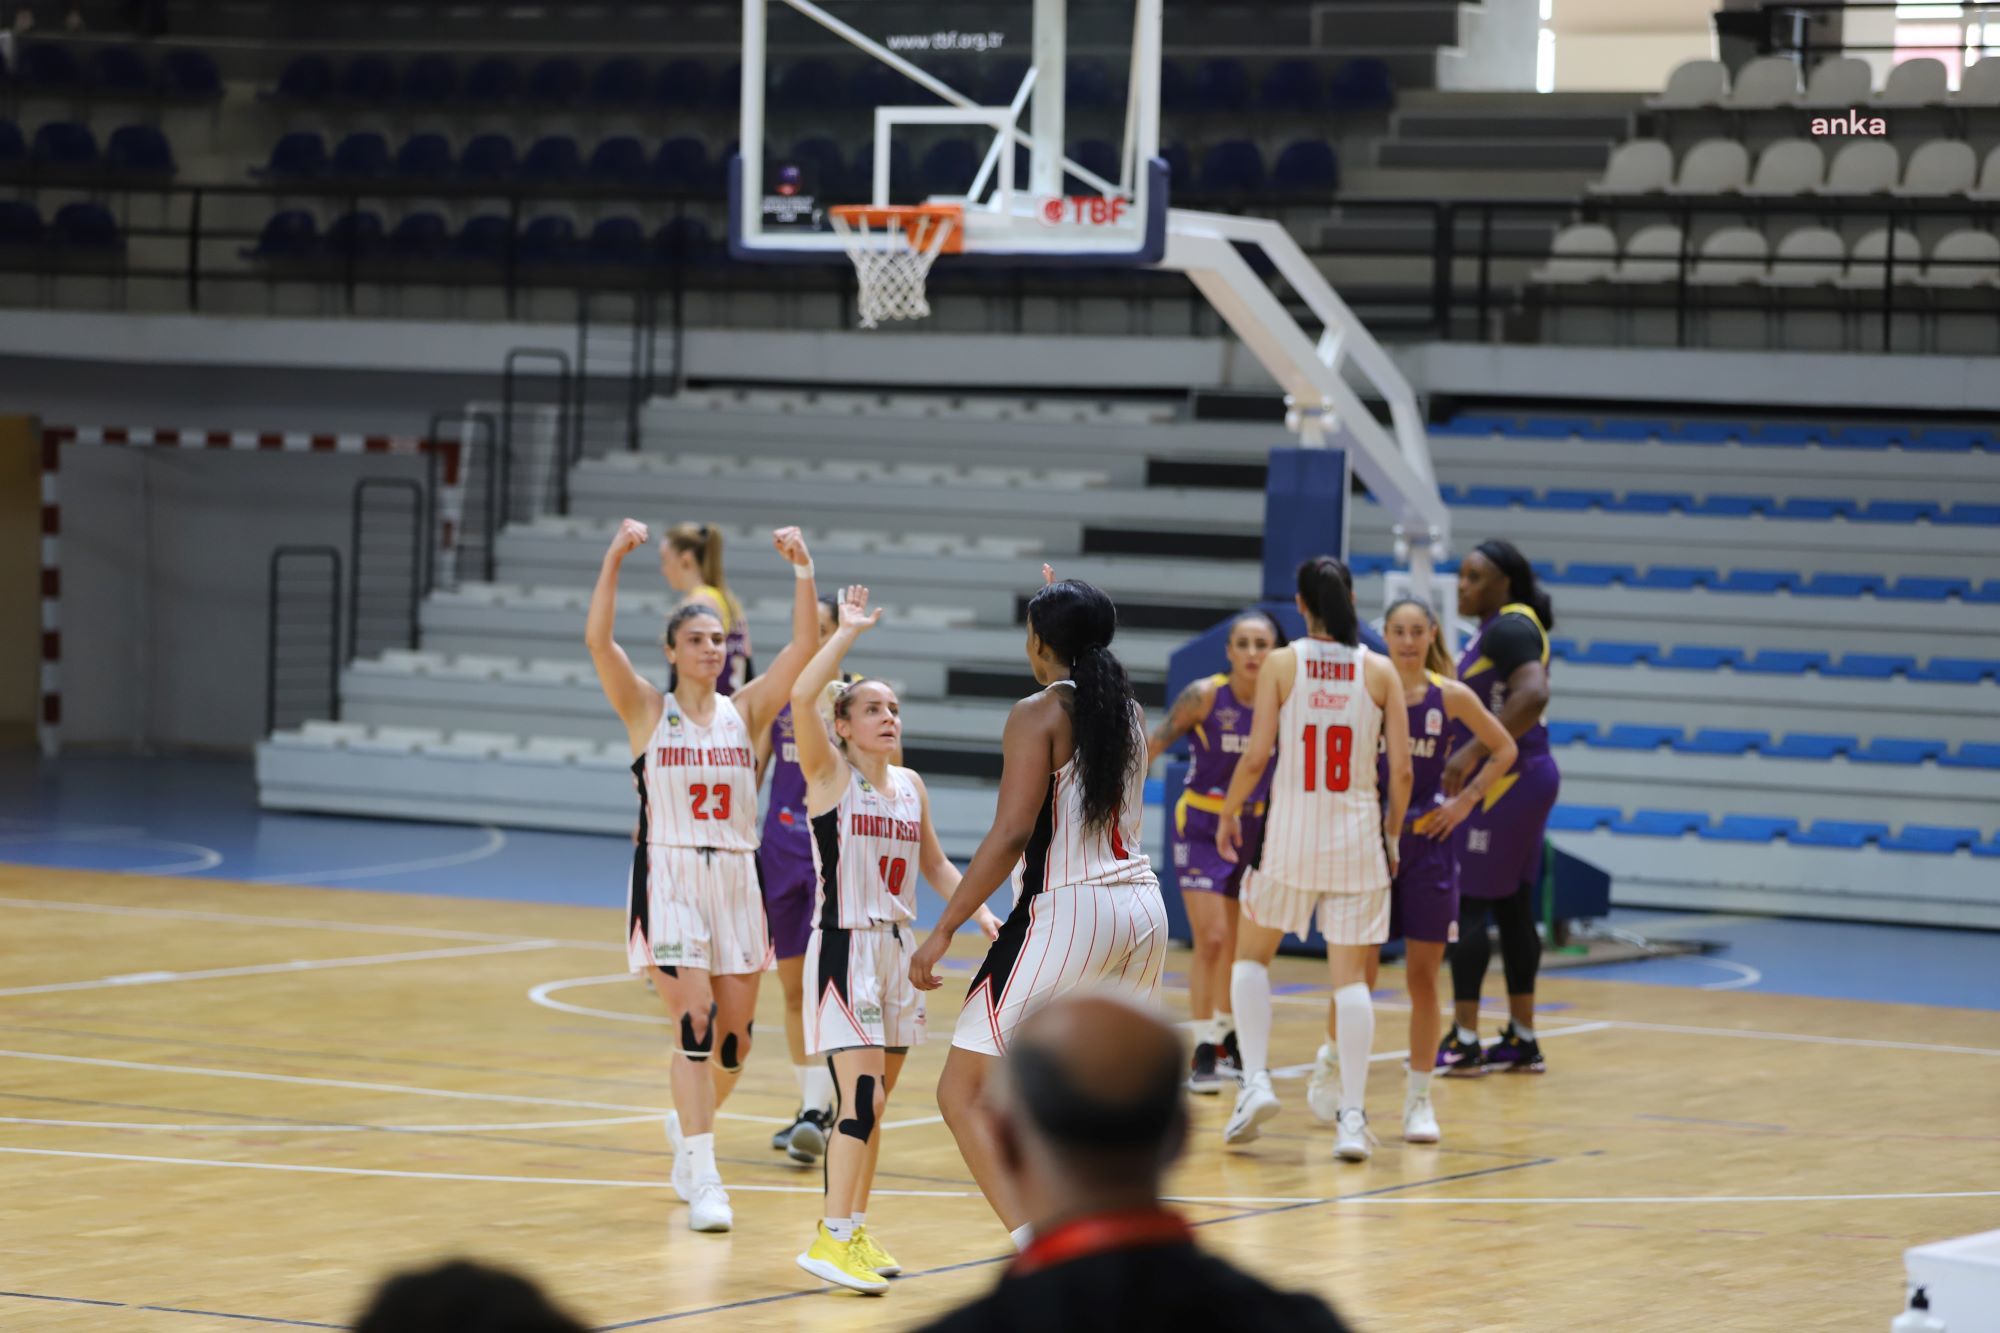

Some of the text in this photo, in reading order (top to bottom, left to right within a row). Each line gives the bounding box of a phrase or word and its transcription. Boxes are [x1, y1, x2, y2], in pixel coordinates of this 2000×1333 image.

[886, 31, 1005, 52] www.tbf.org.tr
[1071, 195, 1126, 225] TBF
[1302, 724, 1353, 792] 18
[689, 784, 731, 820] 23
[878, 855, 907, 896] 10
